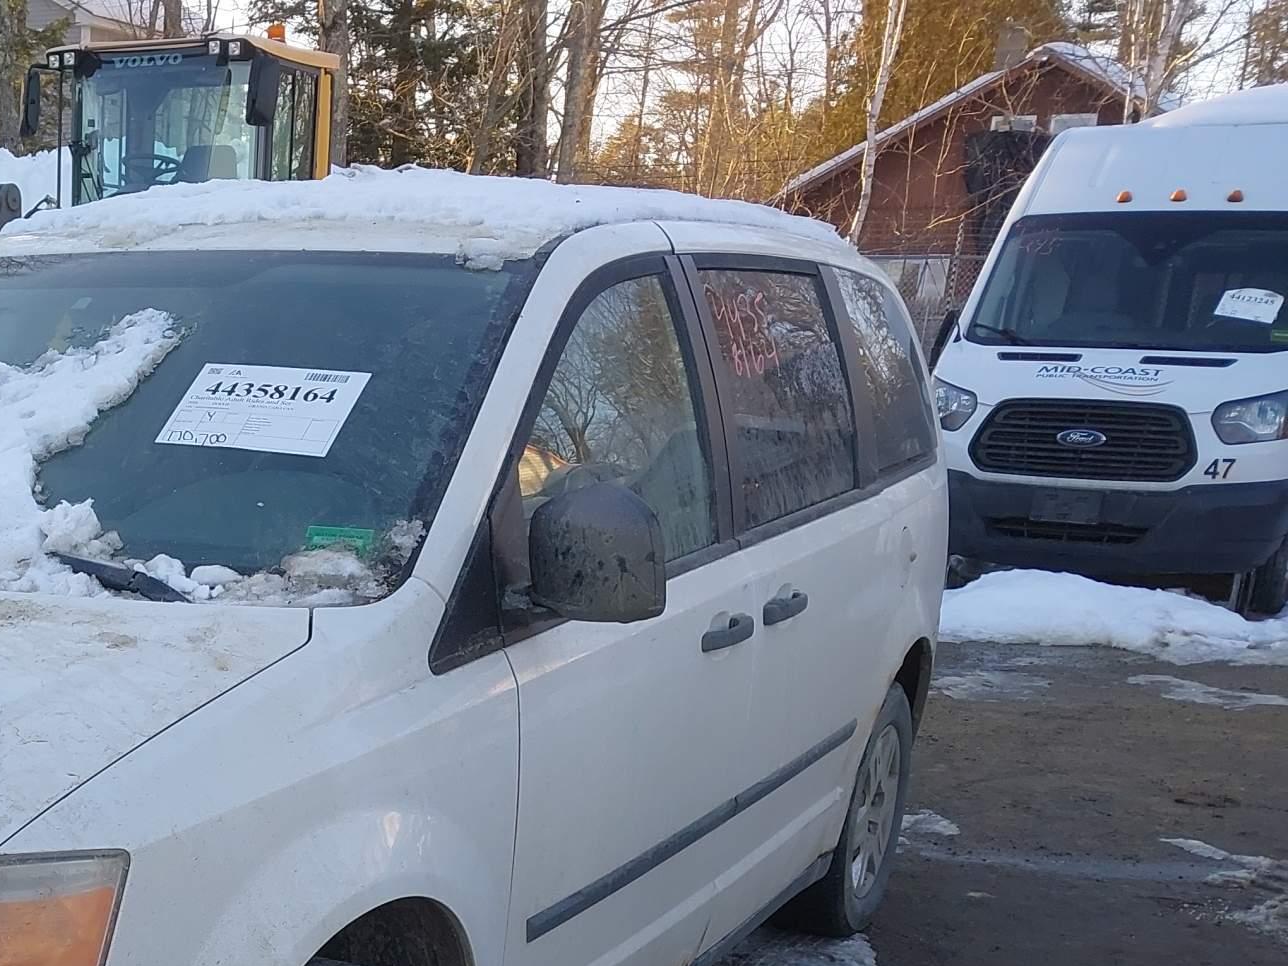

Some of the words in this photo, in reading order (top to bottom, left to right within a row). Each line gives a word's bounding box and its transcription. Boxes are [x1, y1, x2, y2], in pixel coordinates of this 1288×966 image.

[112, 53, 183, 69] VOLVO
[1038, 365, 1164, 377] MID-COAST
[1072, 373, 1159, 382] TRANSPORTATION
[206, 382, 338, 403] 44358164
[1066, 432, 1095, 442] Ford
[1204, 458, 1236, 479] 47
